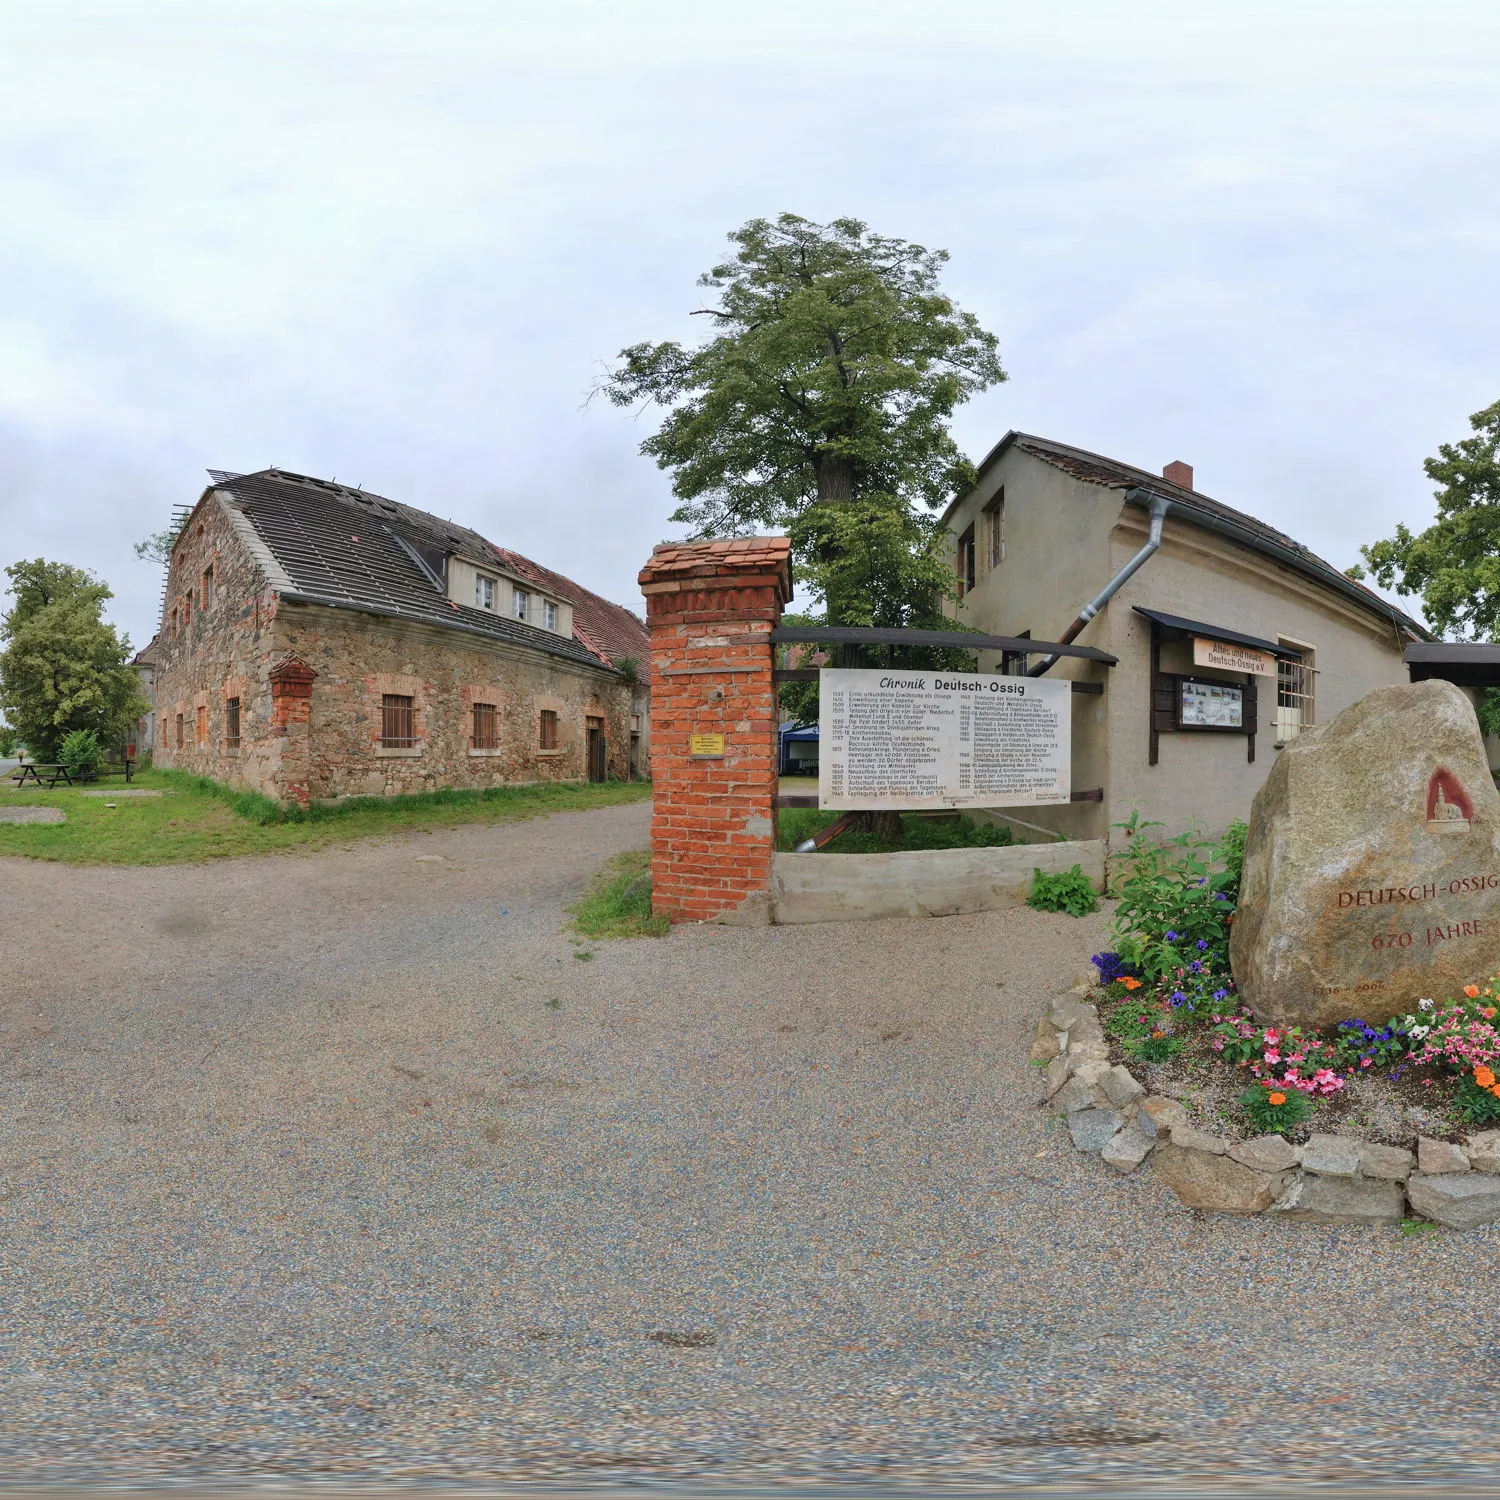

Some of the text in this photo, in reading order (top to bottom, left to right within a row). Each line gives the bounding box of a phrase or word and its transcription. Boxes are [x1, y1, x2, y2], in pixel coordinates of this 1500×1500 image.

[1212, 644, 1262, 662] Altes und neues
[1208, 653, 1254, 672] Deutsch-Ossig
[880, 678, 926, 690] Chronik
[1338, 874, 1498, 908] DEUTSCH-OSSIG
[1372, 920, 1482, 951] 670 JAHRE
[1354, 981, 1384, 992] 2006
